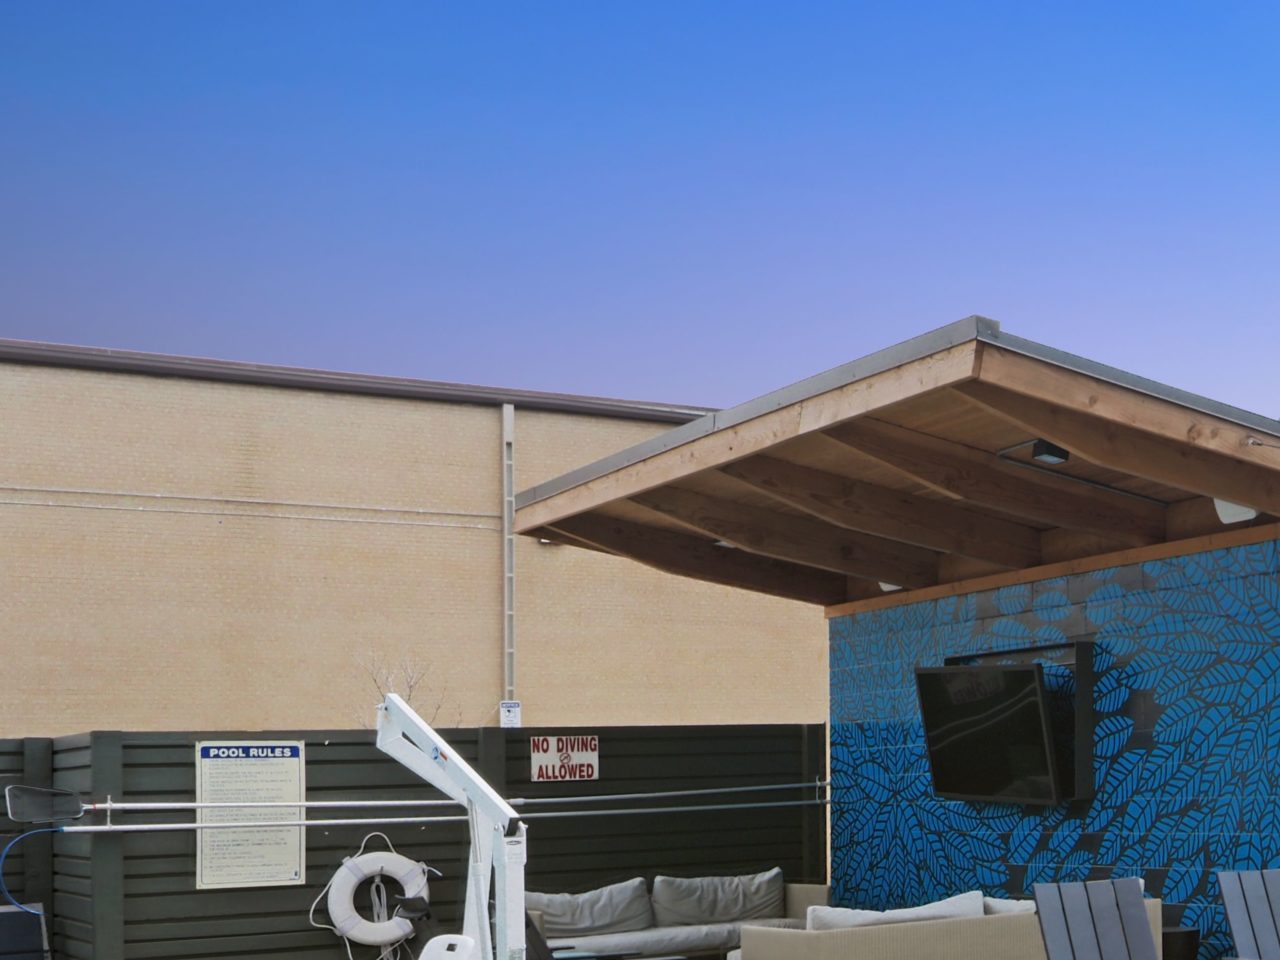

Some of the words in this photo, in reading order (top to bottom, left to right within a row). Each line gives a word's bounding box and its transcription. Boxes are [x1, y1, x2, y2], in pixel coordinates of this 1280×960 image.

[209, 748, 246, 757] POOL
[250, 748, 291, 757] RULES
[532, 737, 549, 753] NO
[556, 736, 597, 753] DIVING
[537, 763, 594, 780] ALLOWED
